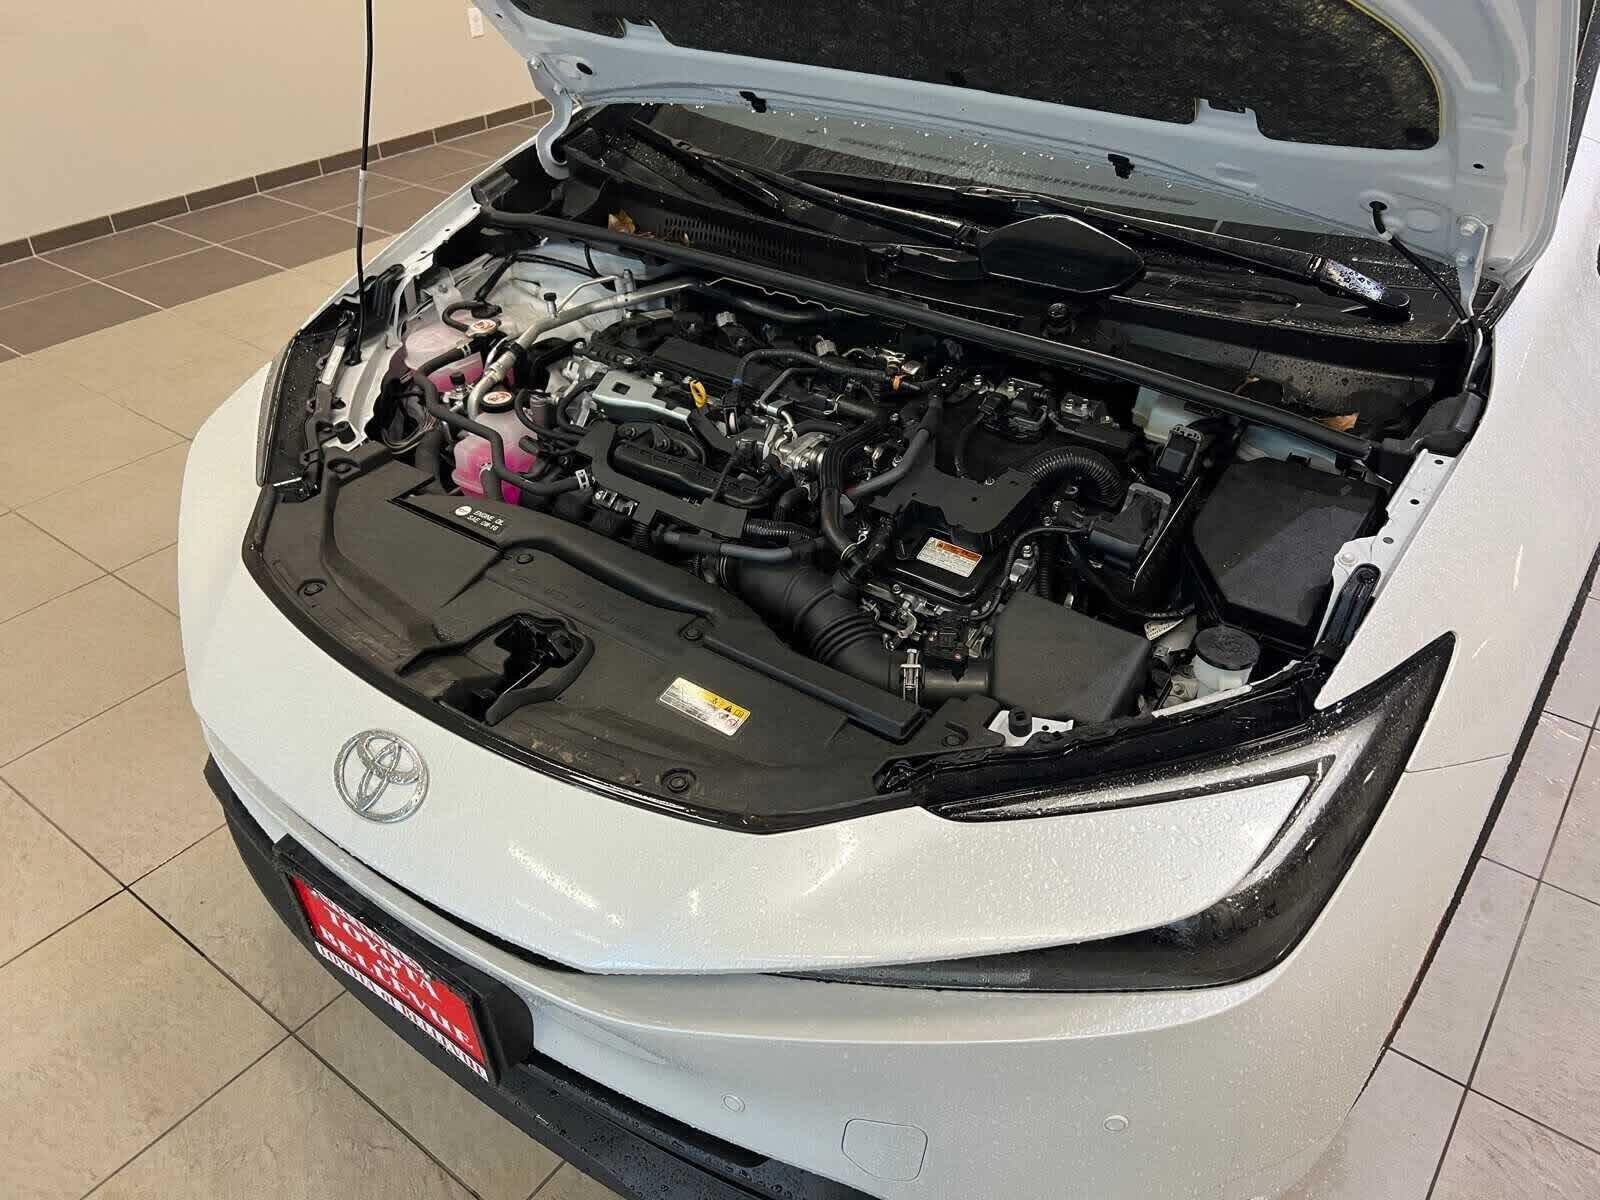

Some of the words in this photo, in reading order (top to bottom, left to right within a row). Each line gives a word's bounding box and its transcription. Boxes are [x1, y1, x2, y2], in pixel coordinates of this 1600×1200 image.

[467, 515, 480, 523] SAE
[473, 510, 495, 521] ENGINE
[323, 905, 441, 1002] TOYOTA
[320, 924, 473, 1050] BELLEVUE
